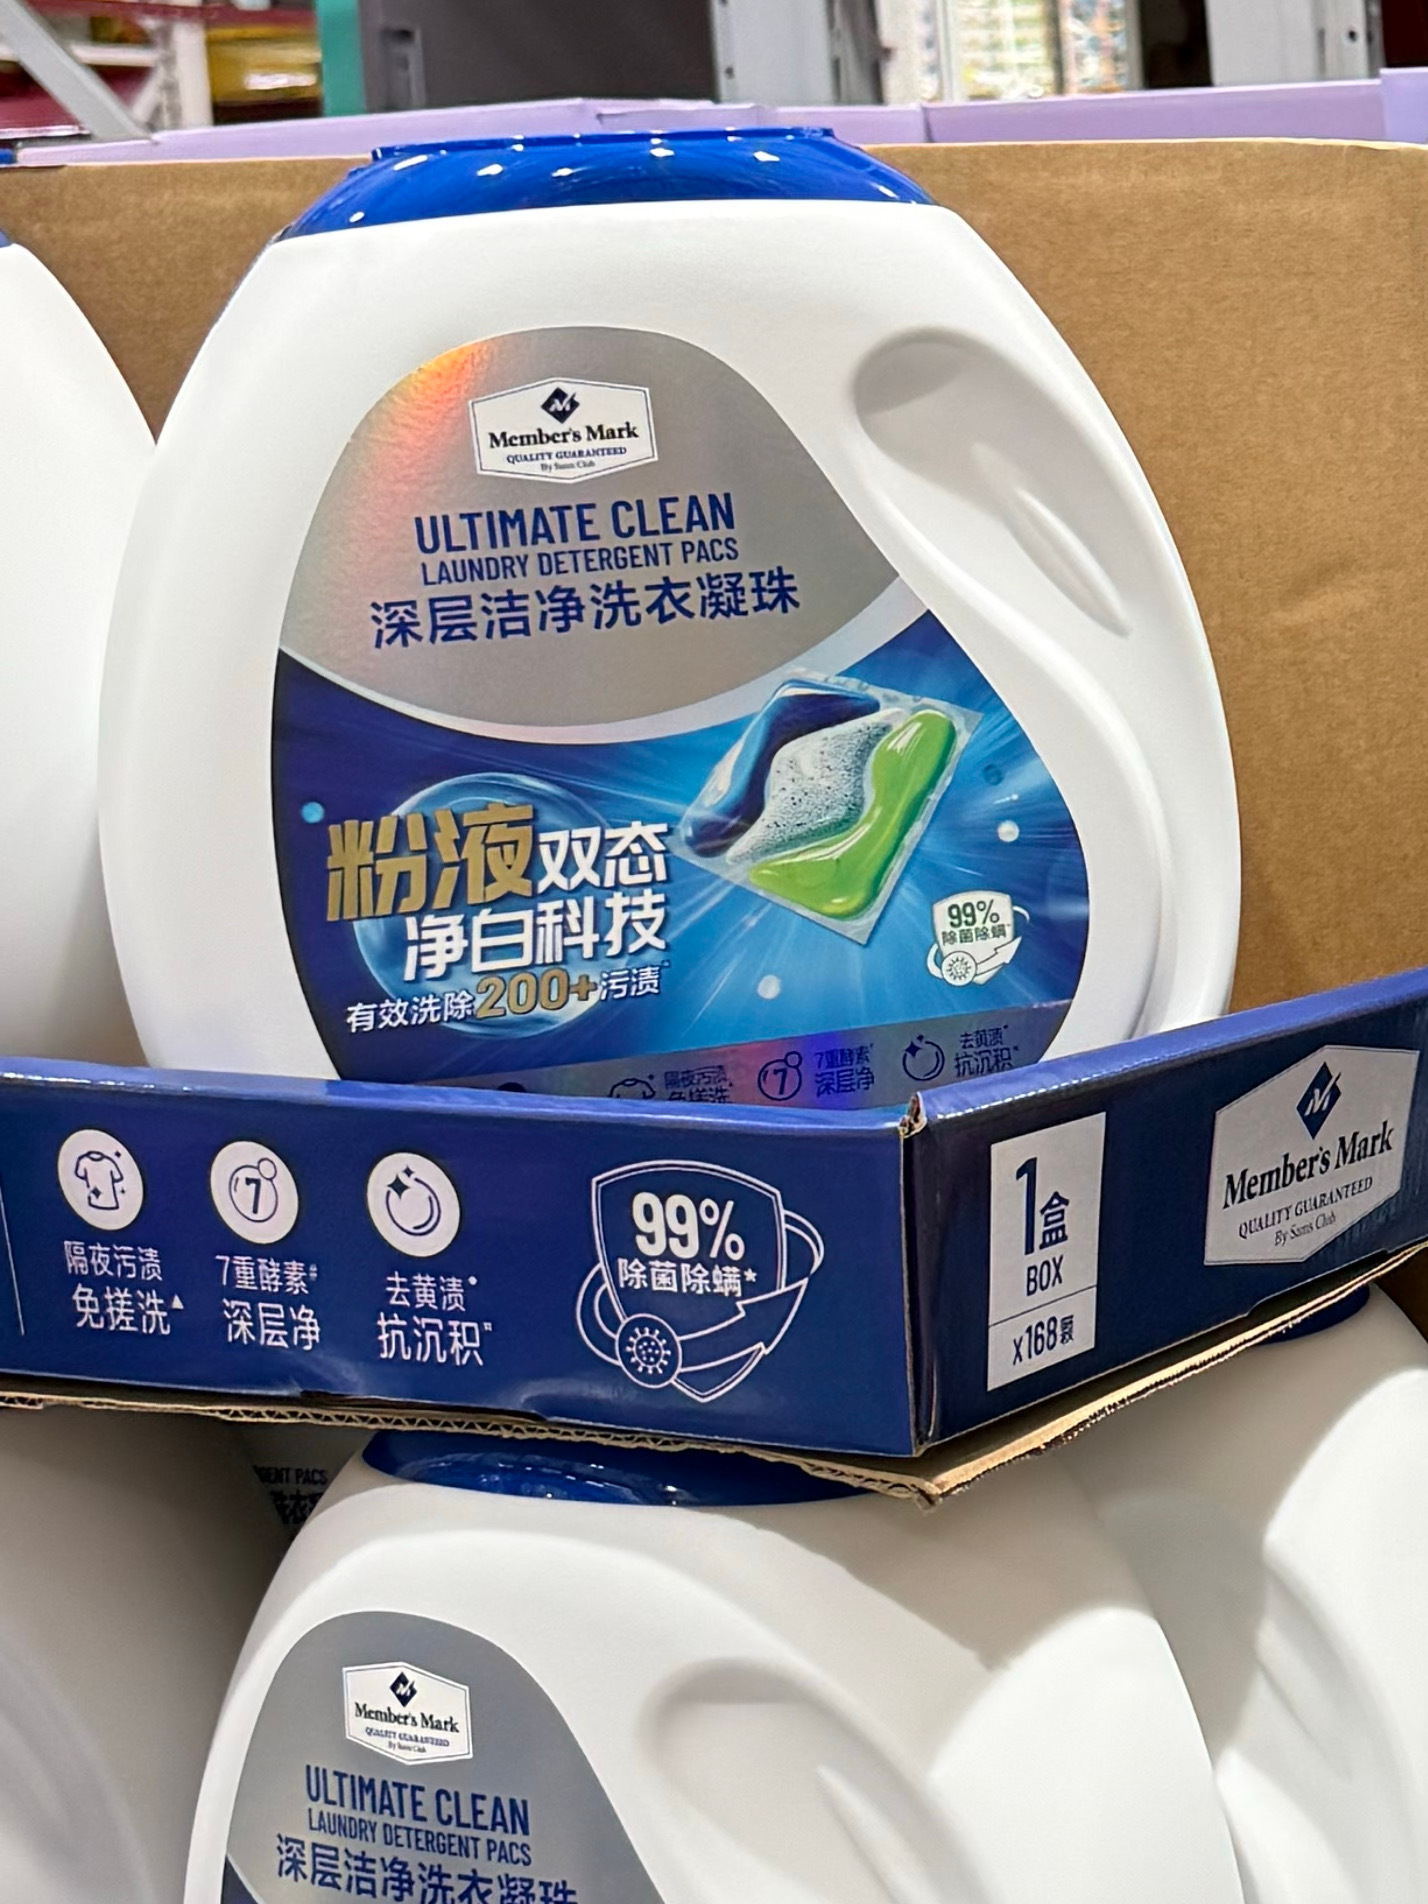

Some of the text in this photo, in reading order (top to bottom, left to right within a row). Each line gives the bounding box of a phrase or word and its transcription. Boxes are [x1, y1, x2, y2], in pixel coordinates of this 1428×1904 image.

[488, 422, 640, 450] Member's Mark
[414, 492, 736, 554] ULTIMATE CLEAN
[421, 536, 740, 586] LAUNDRY DETERGENT PACS
[369, 565, 801, 651] 深层洁净洗衣凝珠
[325, 801, 670, 923] 粉液双态
[403, 889, 668, 982] 净白科技
[947, 899, 1001, 929] 99%
[1222, 1121, 1396, 1210] Member's Mark
[631, 1190, 746, 1263] 99%
[1014, 1155, 1071, 1256] 1盒
[1238, 1175, 1375, 1241] QUALITY GUARANTEED
[63, 1240, 163, 1282] 隔夜污渍
[1025, 1256, 1064, 1298] BOX
[72, 1282, 172, 1336] 免搓洗
[385, 1271, 467, 1313] 去黄渍
[222, 1298, 322, 1352] 深层净
[377, 1312, 484, 1368] 抗沉积
[354, 1702, 460, 1734] Member's Mark
[305, 1763, 531, 1838] ULTIMATE CLEAN
[308, 1807, 533, 1869] LAUNDRY DETERGENT PACS
